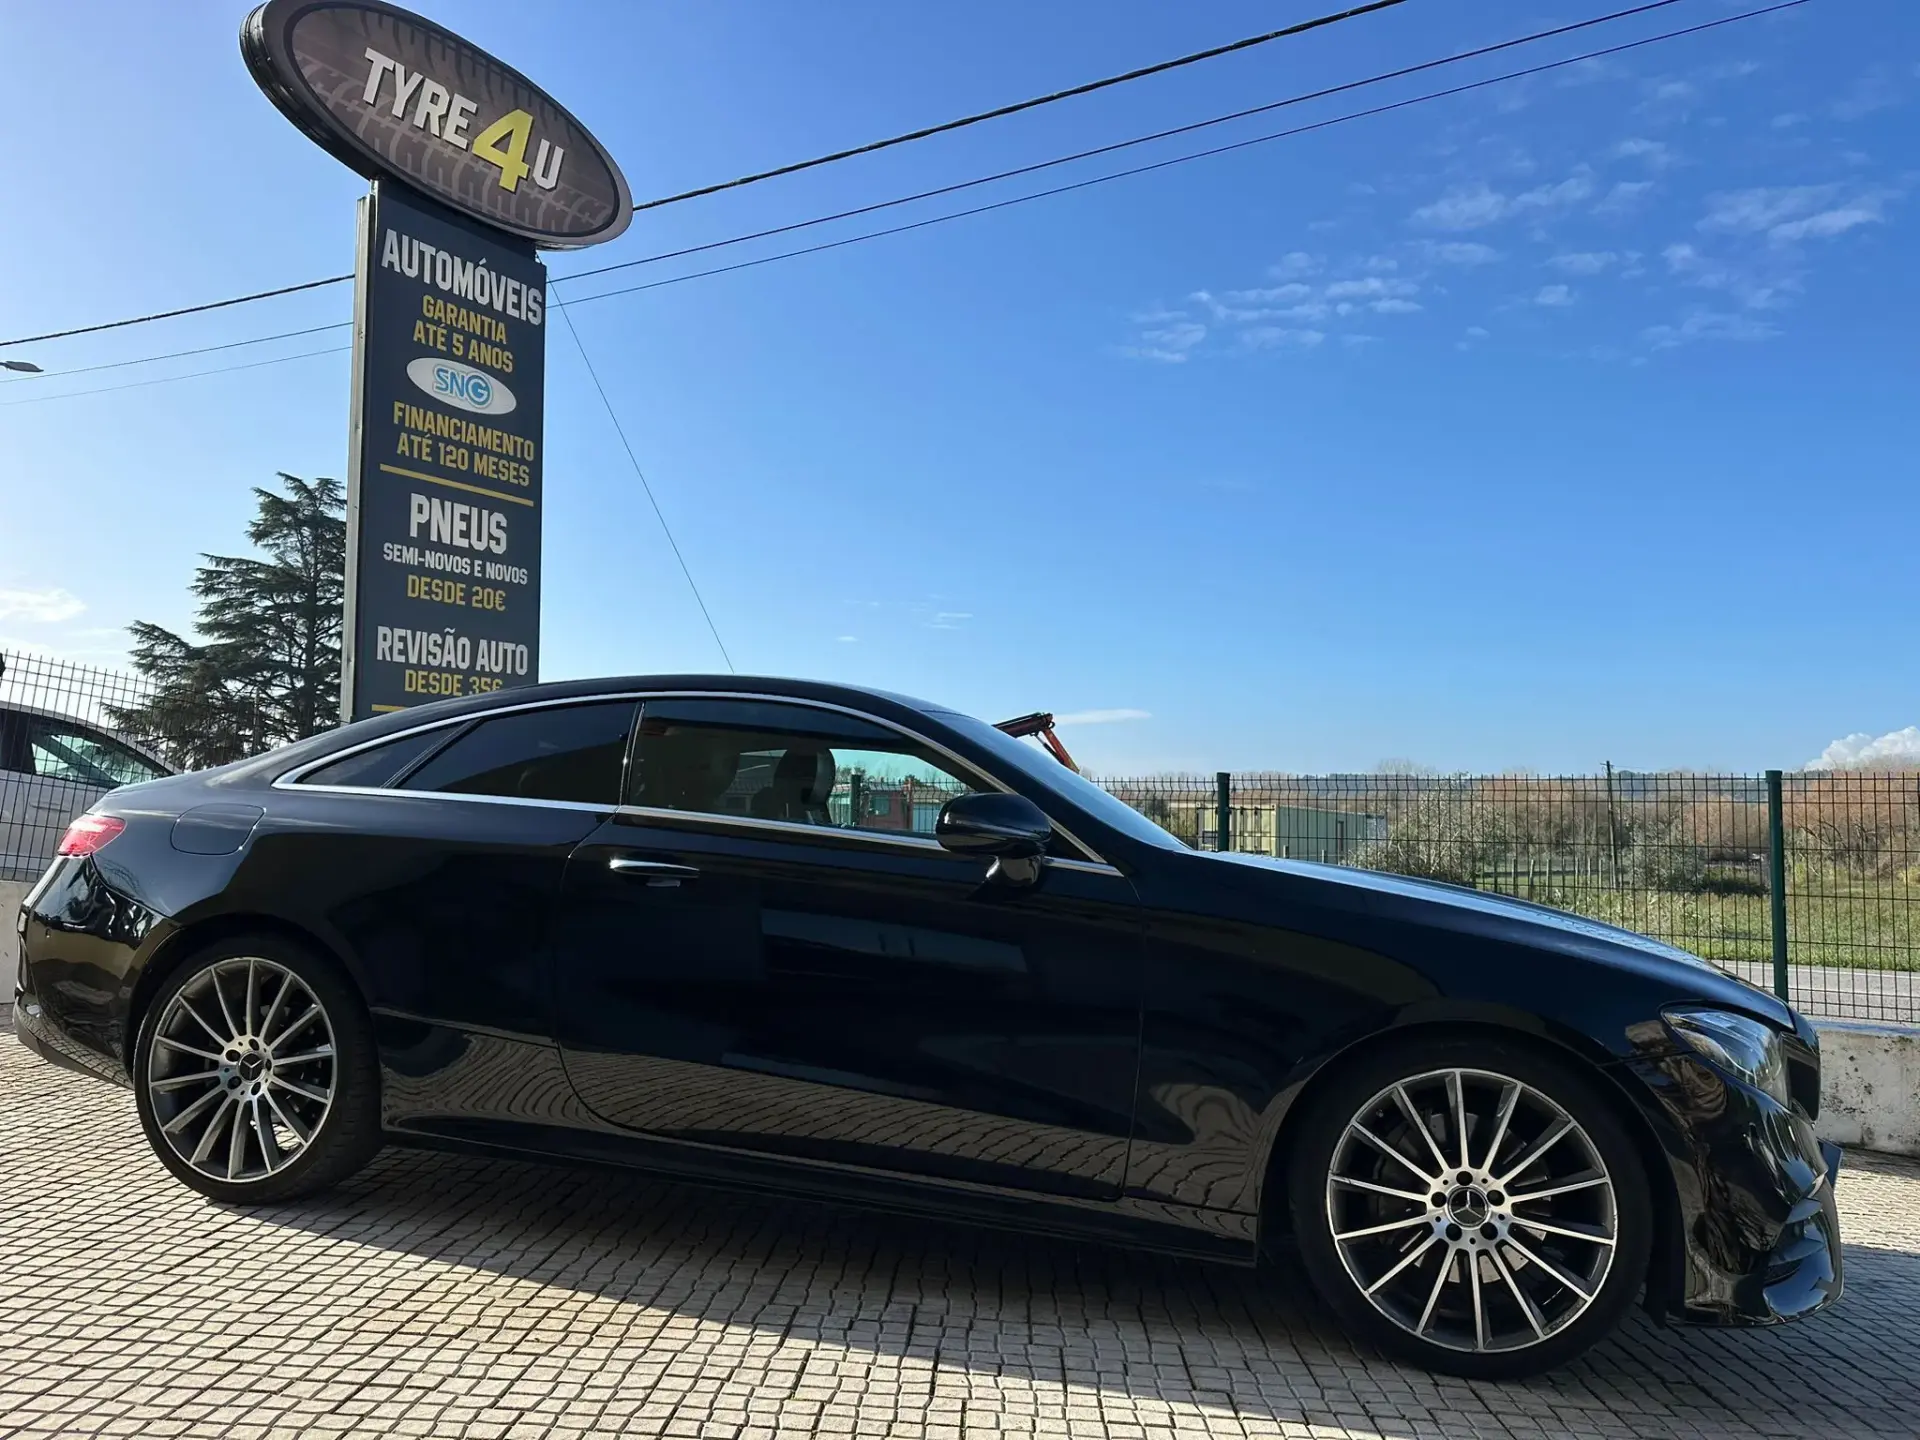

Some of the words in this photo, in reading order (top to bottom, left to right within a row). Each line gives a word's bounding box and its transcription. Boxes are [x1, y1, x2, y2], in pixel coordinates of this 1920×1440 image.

[381, 228, 543, 326] AUTOMÓVEIS
[422, 295, 507, 344] GARANTIA
[413, 320, 448, 352] ATÉ
[452, 333, 464, 356] 5
[468, 339, 514, 373] ANOS
[433, 367, 493, 406] SNG
[393, 401, 535, 462] FINANCIAMENTO
[397, 432, 432, 462] ATÉ
[438, 443, 468, 470] 120
[474, 452, 530, 487] MESES
[409, 492, 508, 555] PNEUS
[383, 542, 471, 575] SEMI-NOVOS
[474, 560, 482, 577] E
[485, 561, 528, 585] NOVOS
[407, 574, 466, 606] DESDE
[472, 586, 507, 611] 20€
[376, 625, 470, 670] REVISÃO
[475, 639, 529, 676] AUTO
[404, 669, 463, 697] DESDE
